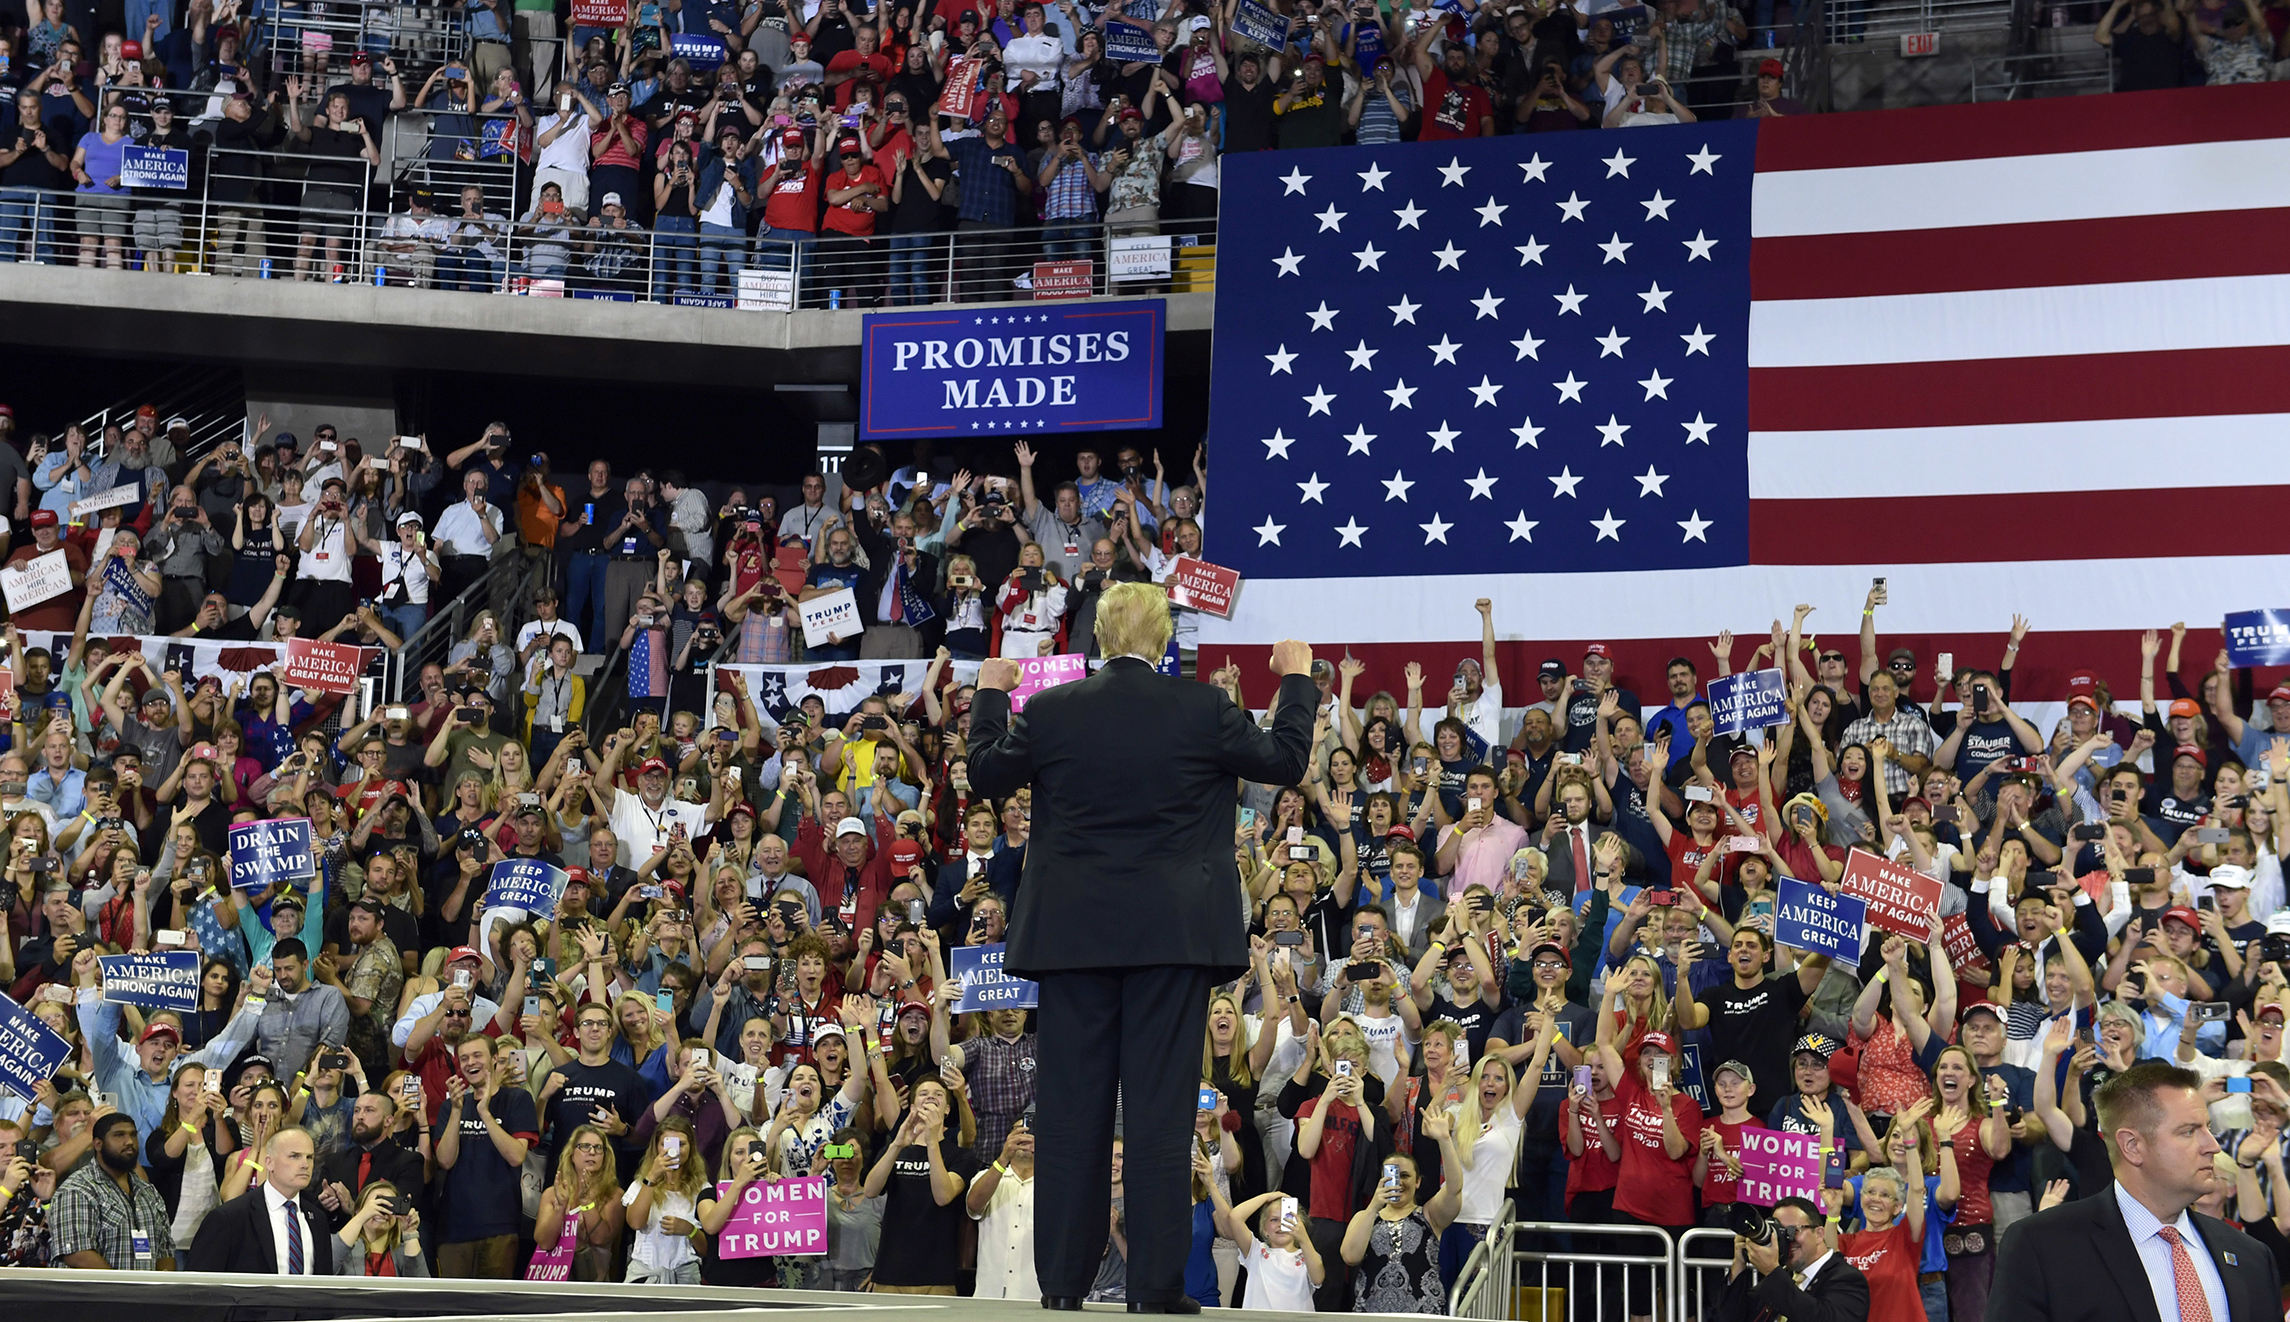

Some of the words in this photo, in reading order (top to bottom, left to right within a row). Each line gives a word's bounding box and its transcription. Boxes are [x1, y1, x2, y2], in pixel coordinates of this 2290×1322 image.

[573, 4, 627, 14] AMERICA
[1244, 0, 1284, 27] PROMISES
[1252, 12, 1275, 28] MADE
[1240, 16, 1282, 42] PROMISES
[1246, 28, 1270, 42] KEPT
[674, 43, 722, 52] TRUMP
[1107, 34, 1156, 46] AMERIC
[1908, 34, 1934, 54] EXIT
[1108, 44, 1138, 54] STRONG
[946, 60, 970, 112] AMERICA
[956, 84, 968, 110] GREAT
[964, 63, 974, 84] AGAIN
[144, 152, 166, 160] MAKE
[124, 159, 186, 174] AMERICA
[124, 170, 158, 180] STRONG
[158, 173, 185, 182] AGAIN
[1112, 252, 1168, 264] AMERICA
[1053, 266, 1072, 274] MAKE
[744, 282, 788, 291] AMERICA
[1036, 276, 1090, 287] AMERICA
[680, 298, 705, 306] AGAIN
[707, 298, 728, 308] SAFE
[743, 299, 788, 308] AMERICA
[893, 330, 1130, 371] PROMISES
[941, 376, 1077, 410] MADE
[820, 456, 847, 474] 11
[8, 561, 63, 589] AMERICAN
[1195, 567, 1217, 580] MAKE
[12, 578, 67, 606] AMERICAN
[26, 578, 47, 590] HIRE
[111, 571, 130, 590] SAFE
[128, 588, 148, 612] AGAIN
[1176, 572, 1231, 598] AMERICA
[1174, 585, 1200, 599] GREAT
[1200, 593, 1225, 606] AGAIN
[806, 602, 852, 622] TRUMP
[812, 612, 849, 628] PENCE
[2230, 624, 2289, 638] TRUM
[2237, 636, 2290, 646] PENC
[311, 648, 336, 658] MAKE
[287, 655, 355, 675] AMERICA
[290, 669, 319, 680] GREAT
[320, 673, 350, 684] AGAIN
[1034, 678, 1060, 688] FOR
[1730, 680, 1757, 693] MAKE
[1712, 688, 1784, 714] AMERICA
[1719, 712, 1744, 725] SAFE
[1746, 705, 1778, 719] AGAIN
[1968, 736, 2010, 748] STAUBER
[1971, 750, 2005, 758] CONGRESS
[236, 826, 300, 850] DRAIN
[256, 846, 281, 858] THE
[235, 854, 307, 878] SWAMP
[512, 865, 543, 877] KEEP
[1879, 868, 1910, 888] MAKE
[489, 876, 559, 901] AMERICA
[1845, 872, 1934, 914] AMERICA
[500, 892, 536, 904] GREAT
[1808, 892, 1837, 910] KEEP
[1779, 903, 1859, 940] AMERICA
[1890, 908, 1926, 928] AGAIN
[1802, 929, 1839, 949] GREAT
[1944, 921, 1969, 941] MAKE
[134, 956, 167, 965] MAKE
[981, 952, 1006, 964] KEE
[106, 964, 197, 986] AMERICA
[107, 978, 156, 995] STRONG
[159, 987, 196, 1000] AGAIN
[978, 988, 1020, 1001] GREAT
[1725, 992, 1768, 1010] TRUMP
[8, 1015, 41, 1043] MAKE
[1361, 1026, 1396, 1037] RUMP
[1643, 1032, 1667, 1040] TRUMP
[0, 1025, 52, 1079] ERICA
[0, 1053, 37, 1086] AGAIN
[564, 1087, 616, 1098] TRUMP
[1630, 1108, 1663, 1126] TRUM
[1633, 1131, 1659, 1148] 20/20
[895, 1161, 930, 1170] TRUM
[1768, 1163, 1804, 1179] FOR
[753, 1211, 790, 1224] FOR
[726, 1228, 820, 1252] TRUMP
[528, 1264, 568, 1280] TRUMP
